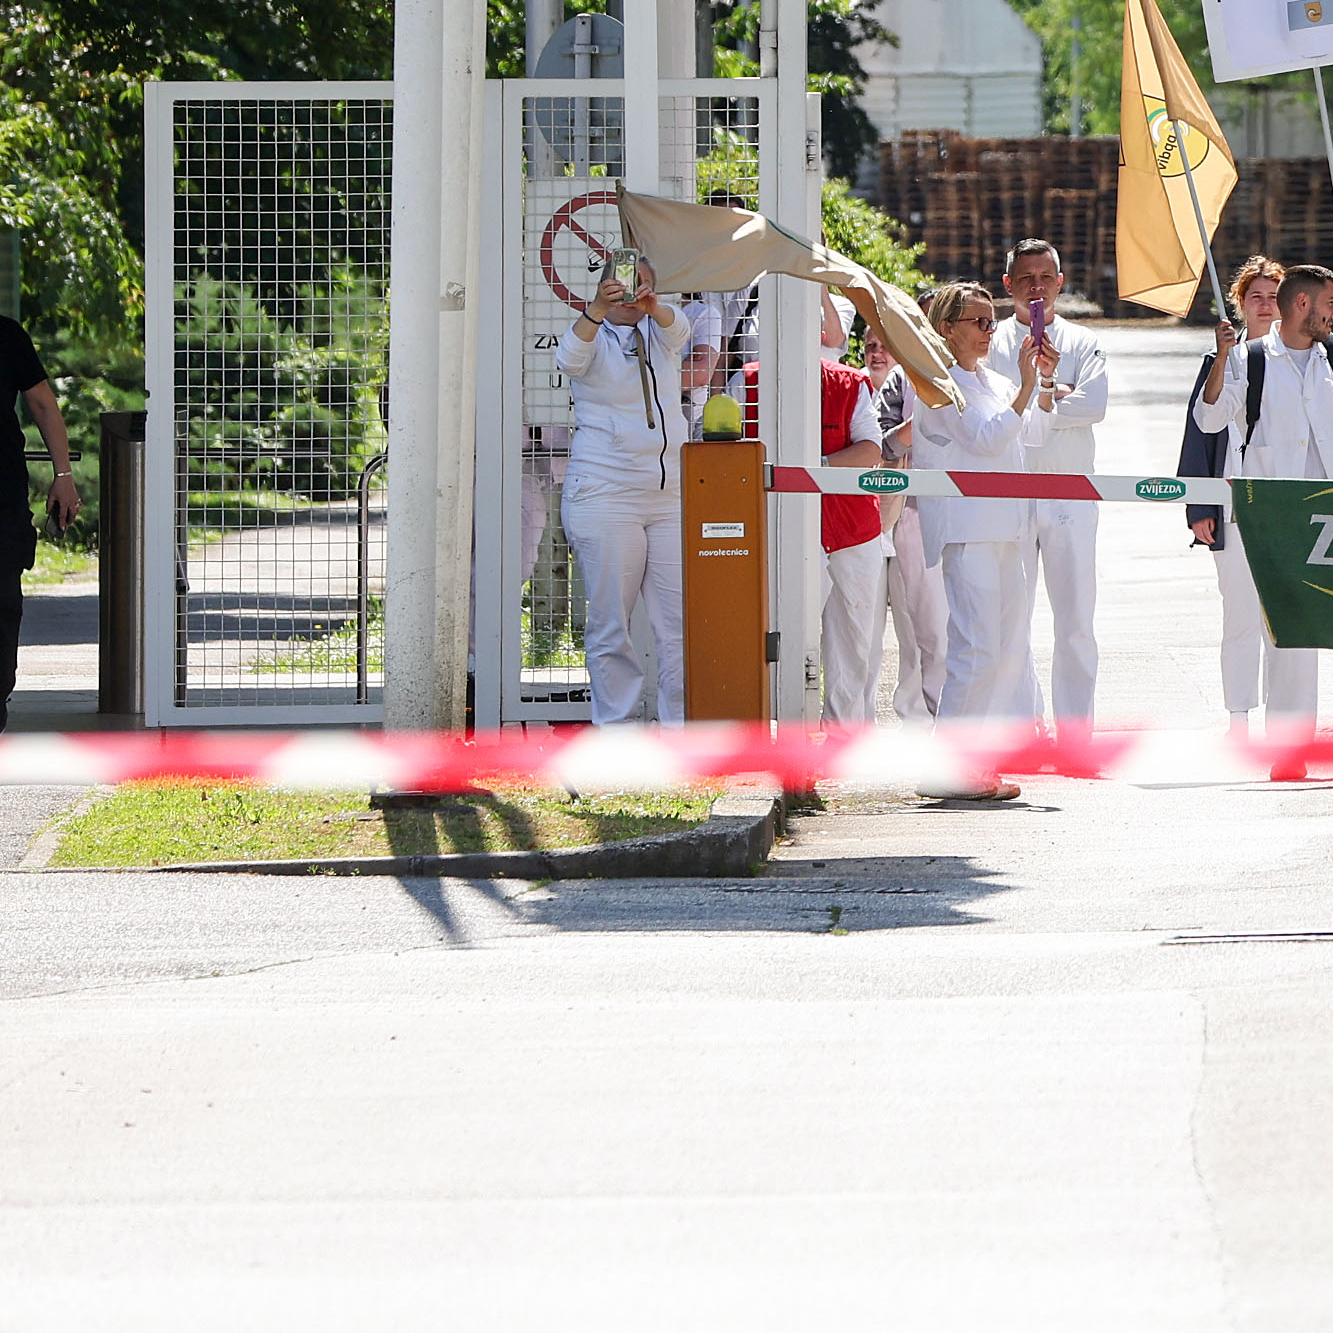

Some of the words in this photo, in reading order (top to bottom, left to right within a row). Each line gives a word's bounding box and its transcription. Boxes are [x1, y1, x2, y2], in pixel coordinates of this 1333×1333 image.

[862, 477, 905, 488] ZVIJEZDA
[1139, 484, 1182, 496] ZVIJEZDA
[698, 548, 749, 557] novotecnica
